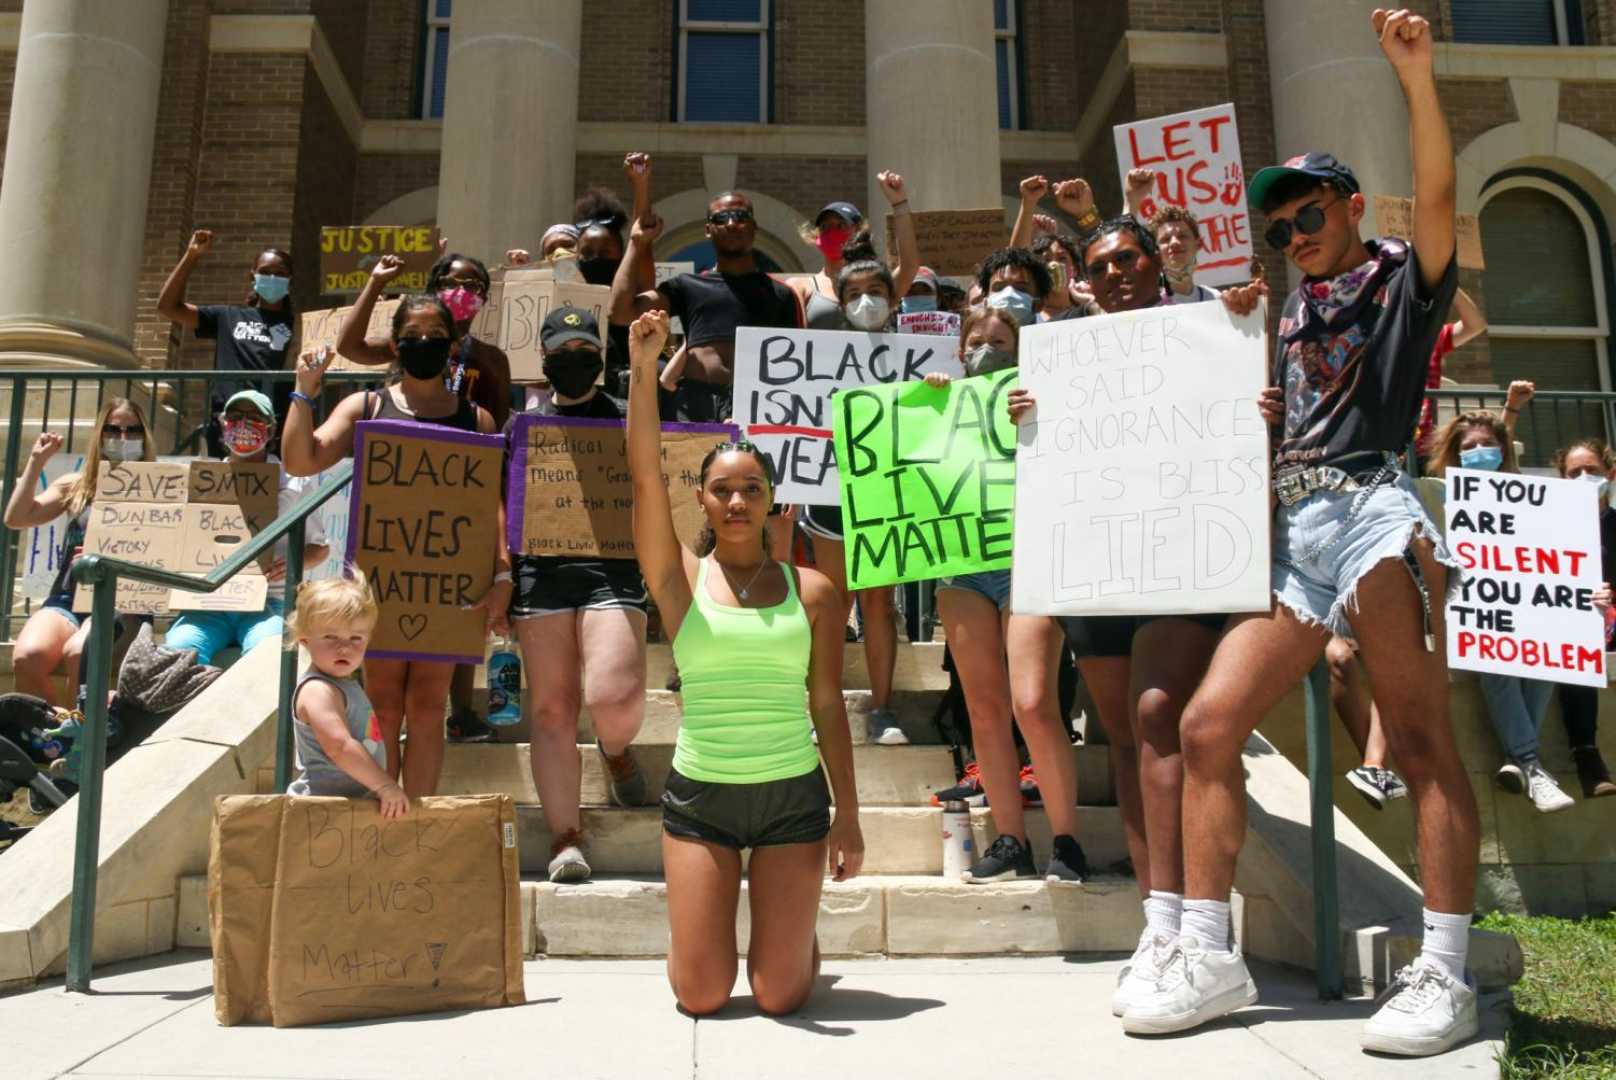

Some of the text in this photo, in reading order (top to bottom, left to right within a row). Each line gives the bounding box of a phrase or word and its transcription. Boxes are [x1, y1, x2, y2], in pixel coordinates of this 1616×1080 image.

[1129, 115, 1230, 168] LET
[1156, 160, 1218, 208] US
[321, 228, 432, 253] JUSTICE
[759, 336, 934, 385] BLACK
[1031, 317, 1191, 376] WHOEVER
[750, 387, 839, 427] ISN'
[1065, 365, 1164, 410] SAID
[844, 371, 1018, 477] BLAC
[1023, 398, 1257, 460] IGNORANCE
[194, 470, 269, 497] SMTX
[366, 439, 485, 488] BLACK
[761, 437, 838, 486] WEA
[1063, 457, 1264, 506] IS BLISS
[847, 459, 1016, 529] LIVE
[1453, 475, 1546, 506] IF YOU
[102, 508, 183, 524] DUNBAR
[361, 503, 472, 558] LIVES
[1450, 509, 1515, 535] ARE
[851, 511, 1014, 583] MATTE
[1053, 503, 1253, 603] LIED
[1456, 542, 1587, 577] SILENT
[1461, 576, 1593, 611] YOU ARE
[1450, 605, 1515, 632] THE
[1458, 632, 1602, 674] PROBLEM
[306, 804, 440, 868] Black
[347, 875, 434, 915] Lives
